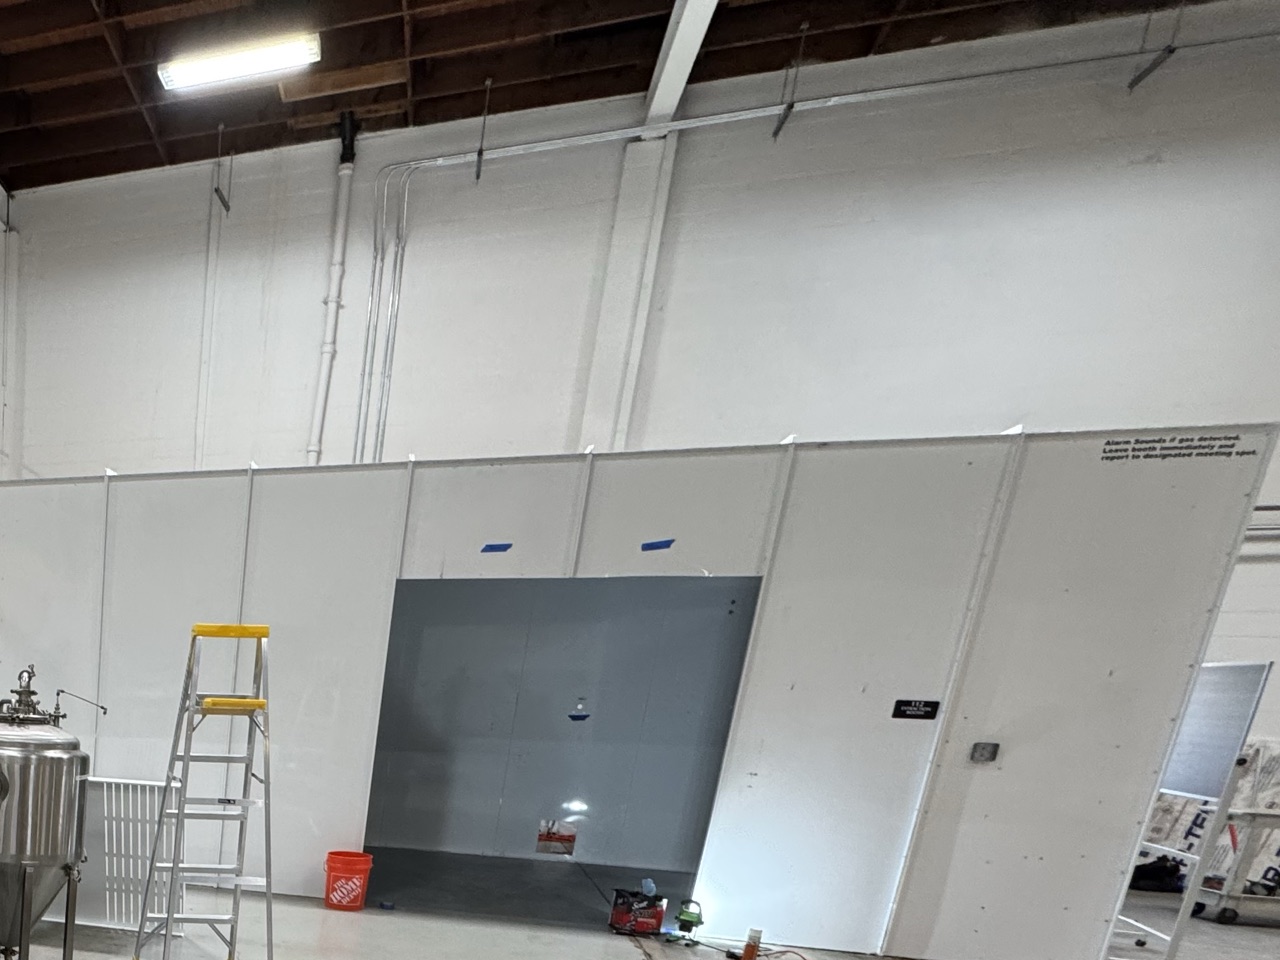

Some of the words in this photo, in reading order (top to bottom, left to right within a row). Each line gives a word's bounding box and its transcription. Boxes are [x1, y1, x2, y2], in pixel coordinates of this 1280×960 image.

[1133, 437, 1167, 445] Sounds
[1143, 451, 1193, 461] designated
[330, 876, 362, 903] HOME
